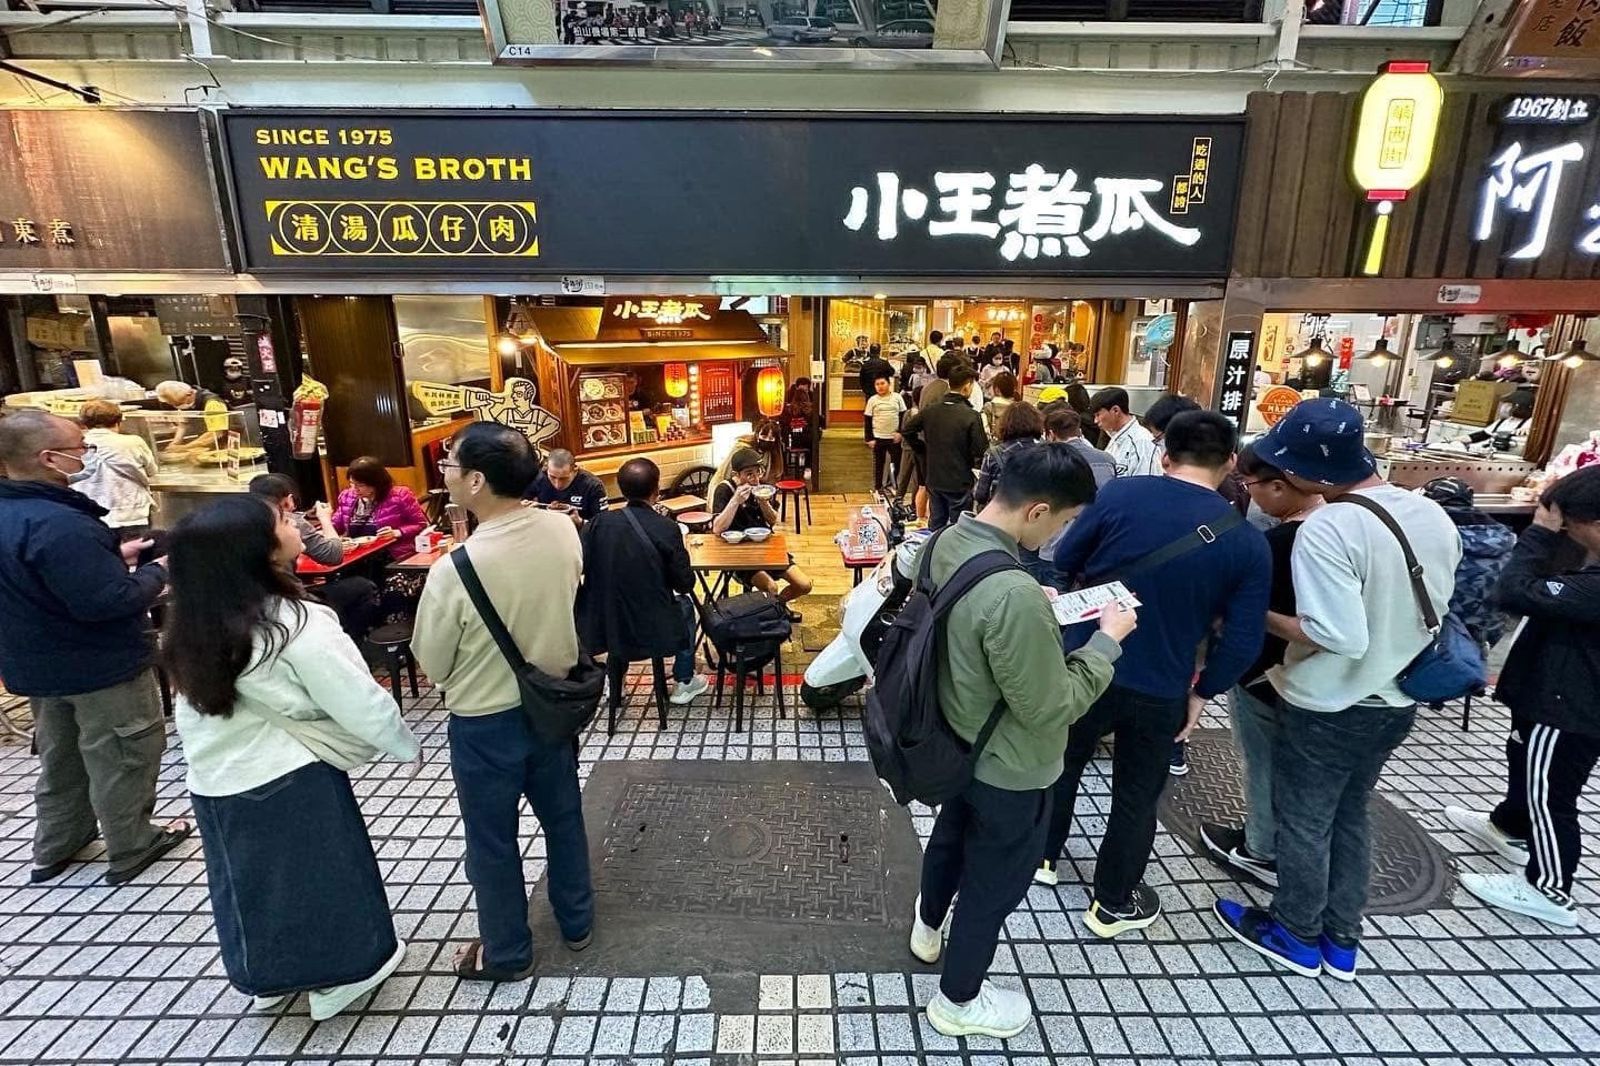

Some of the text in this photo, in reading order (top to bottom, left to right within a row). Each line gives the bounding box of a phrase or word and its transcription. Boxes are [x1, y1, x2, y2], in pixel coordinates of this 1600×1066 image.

[508, 47, 532, 56] C14
[1505, 97, 1590, 121] 1967創立
[256, 129, 393, 145] SINCE 1975
[260, 156, 532, 181] WANG'S BROTH
[1190, 144, 1209, 199] 吃過的人
[843, 163, 1202, 262] 小王煮瓜
[291, 213, 516, 242] 清湯瓜仔肉
[612, 299, 712, 325] 小王煮瓜
[1221, 339, 1250, 428] 原汁排
